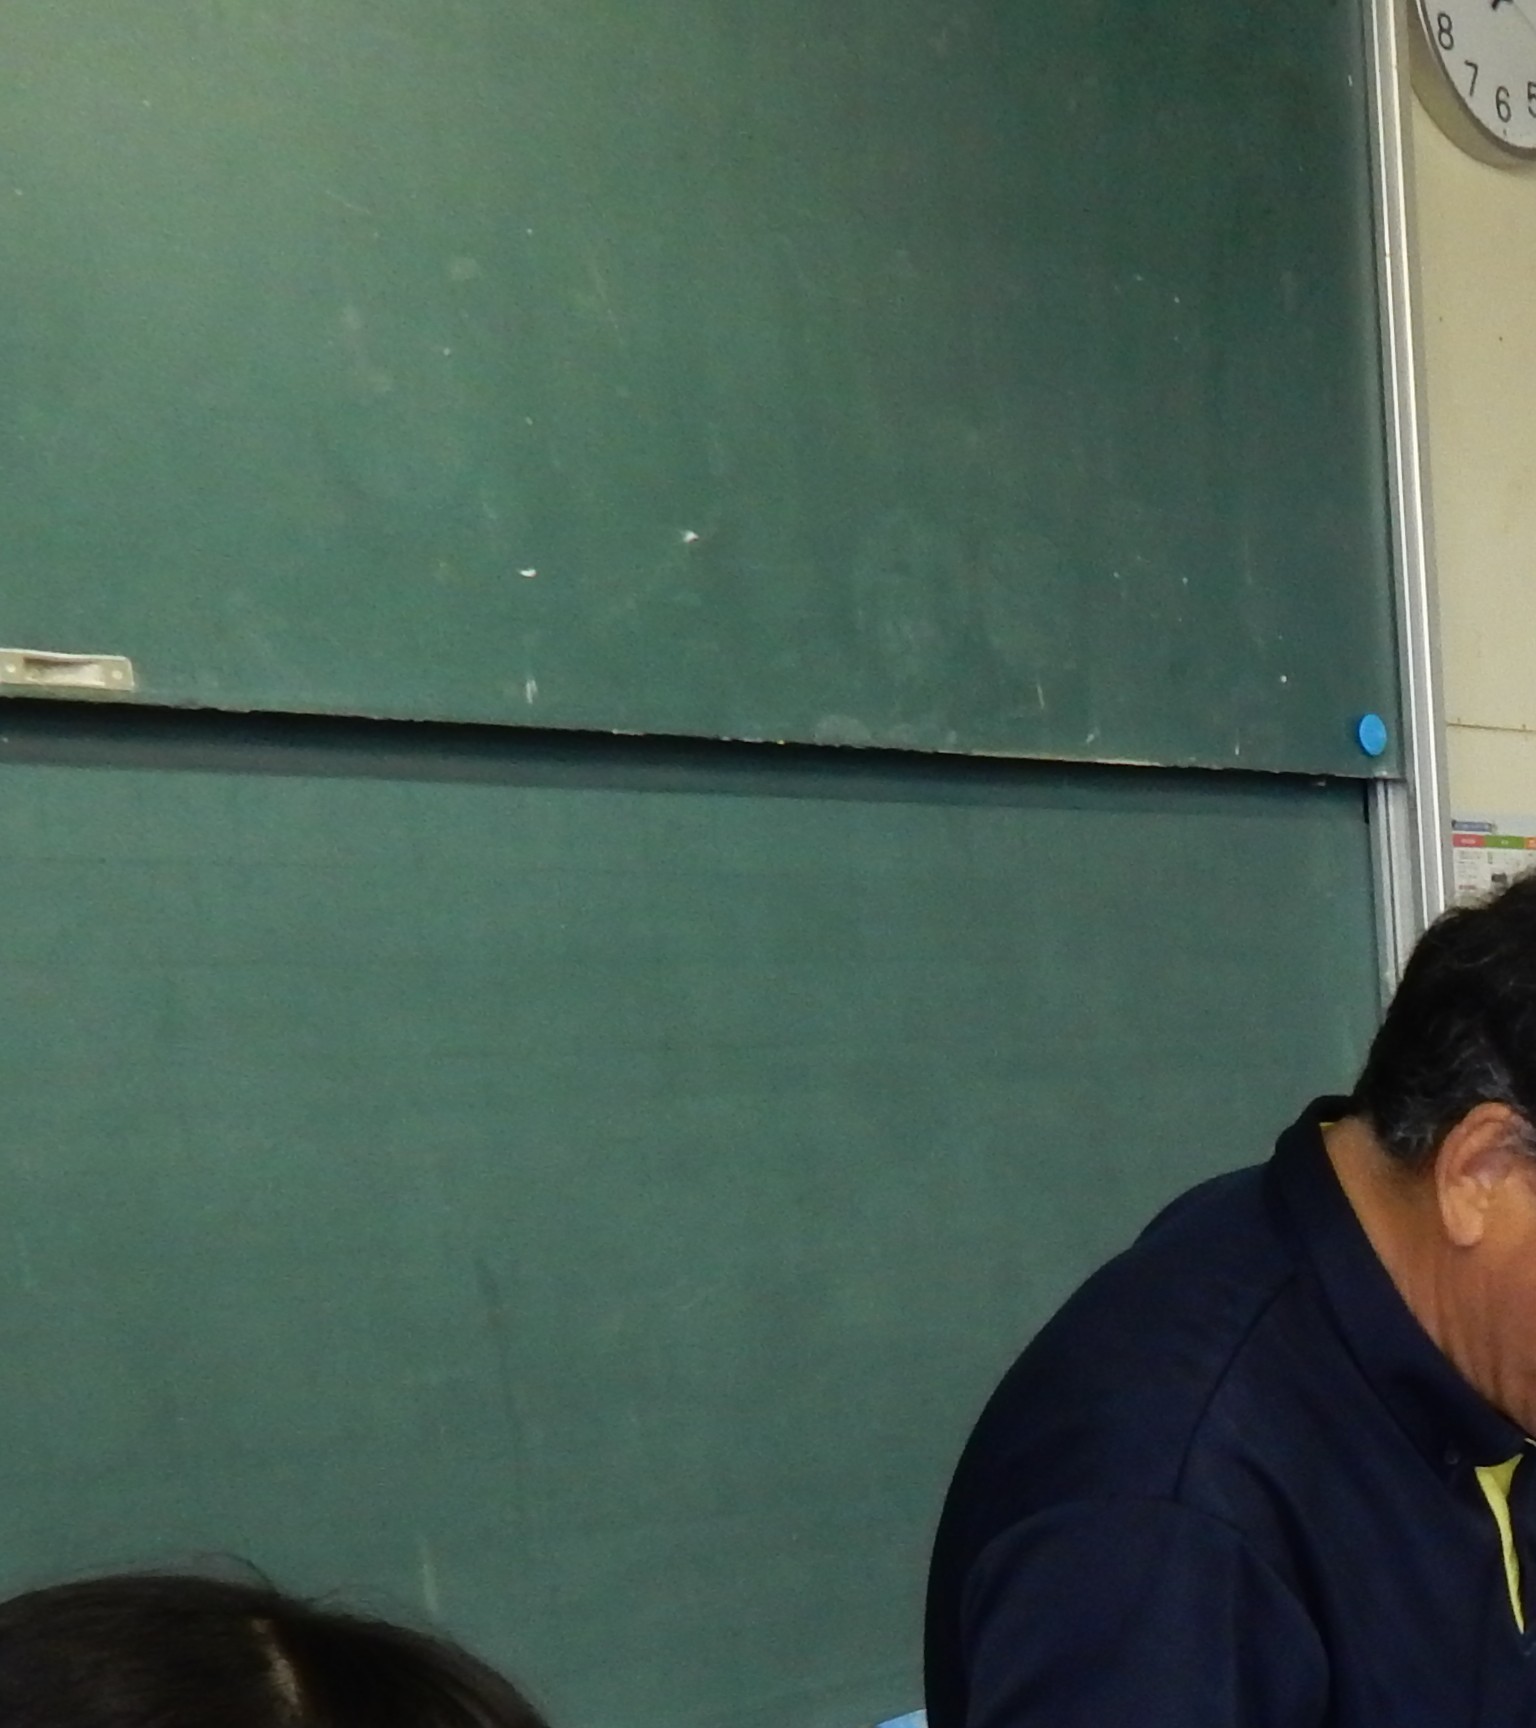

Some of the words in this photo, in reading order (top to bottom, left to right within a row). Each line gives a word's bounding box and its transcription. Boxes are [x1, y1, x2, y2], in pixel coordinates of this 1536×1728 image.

[1437, 12, 1454, 50] 8
[1464, 60, 1479, 97] 7
[1495, 86, 1511, 123] 6
